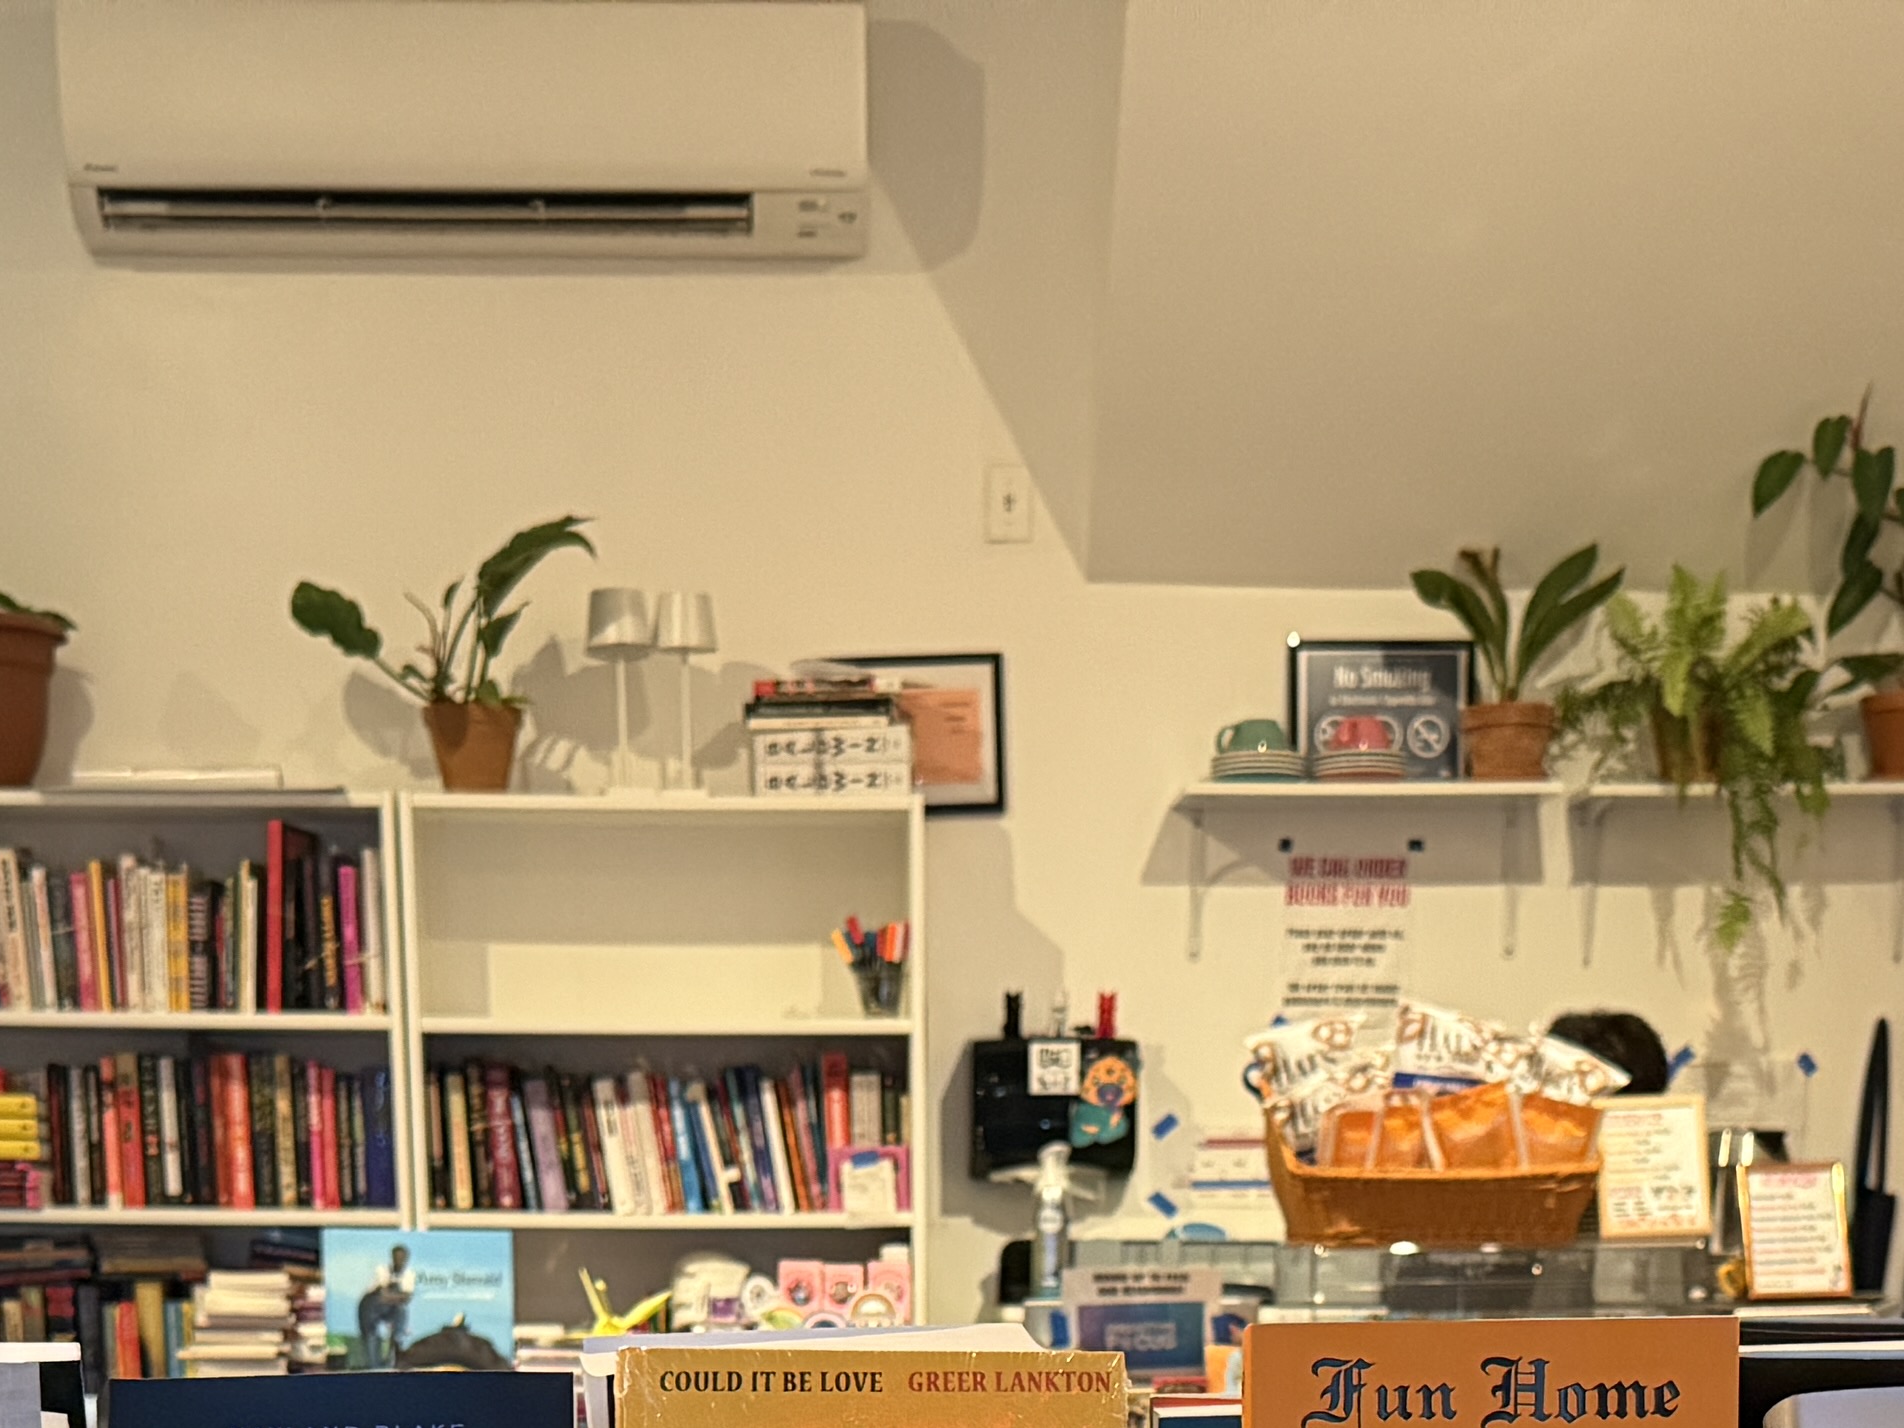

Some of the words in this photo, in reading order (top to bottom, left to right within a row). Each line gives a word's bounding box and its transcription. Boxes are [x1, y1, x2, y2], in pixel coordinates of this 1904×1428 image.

[659, 1370, 743, 1394] COULD
[749, 1370, 775, 1393] IT
[781, 1370, 813, 1393] BE
[820, 1370, 884, 1394] LOVE
[908, 1370, 987, 1394] GREER
[995, 1370, 1112, 1394] LANKTON
